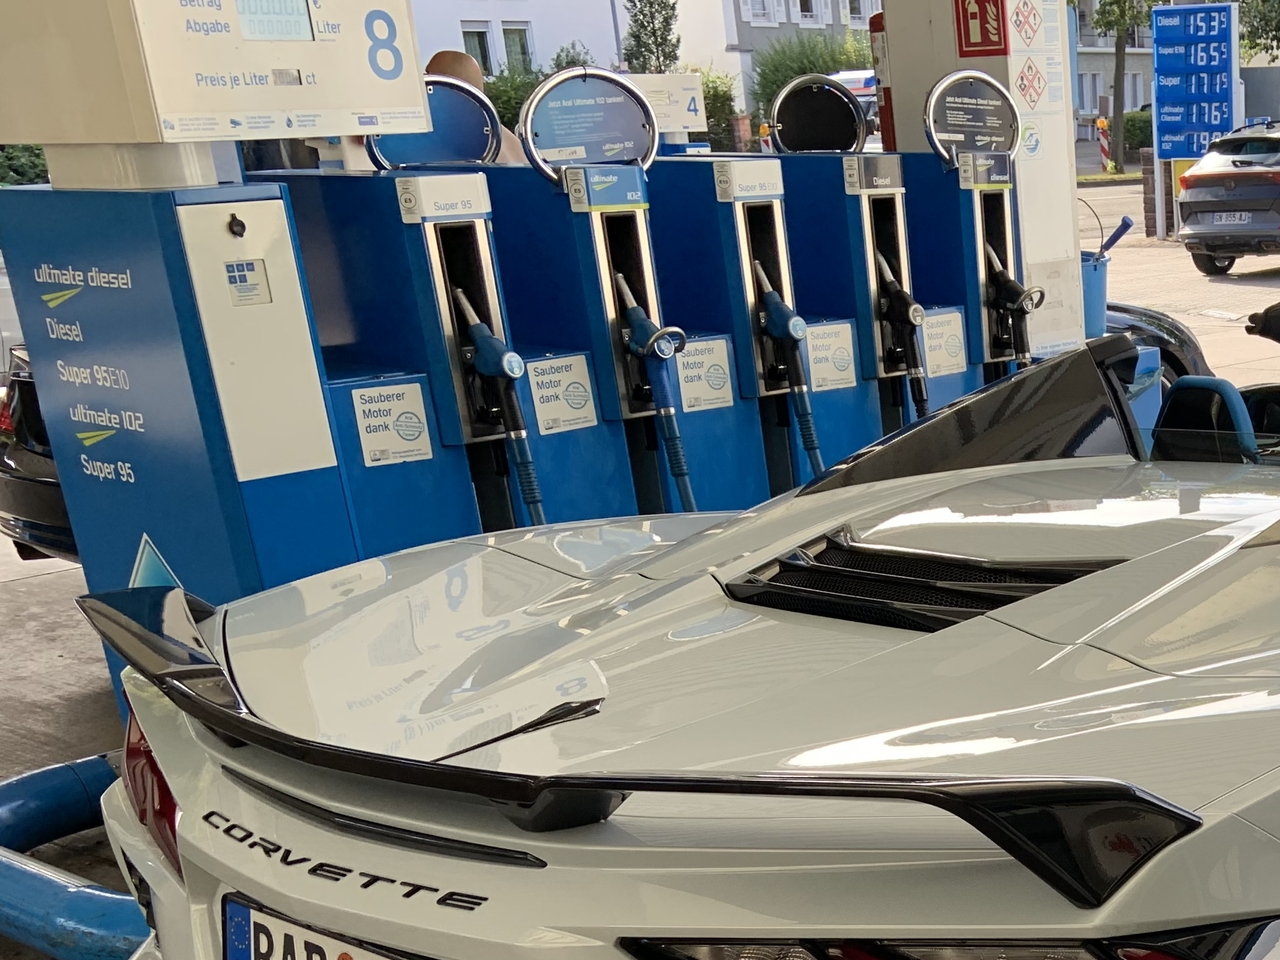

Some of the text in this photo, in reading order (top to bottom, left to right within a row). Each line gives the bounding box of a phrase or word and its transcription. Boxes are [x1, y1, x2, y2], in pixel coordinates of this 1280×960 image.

[1157, 16, 1180, 26] Diesel
[186, 19, 341, 36] Abgabe Liter
[364, 9, 403, 80] 8
[1158, 46, 1174, 55] Super
[196, 72, 226, 86] Preis
[229, 73, 240, 88] je
[244, 72, 269, 86] Liter
[306, 72, 317, 86] ct
[1159, 76, 1181, 86] Super
[687, 96, 699, 116] 4
[1160, 114, 1181, 122] Diesel
[873, 176, 890, 186] Diesel
[738, 184, 757, 192] Super
[627, 192, 641, 200] 102
[434, 200, 472, 212] Super 95
[34, 264, 131, 288] ultimate diesel
[46, 318, 83, 341] Diesel
[810, 331, 840, 340] Sauberer
[681, 347, 714, 358] Sauberer
[812, 344, 831, 352] Motor
[813, 355, 830, 364] dank
[533, 364, 572, 377] Sauberer
[682, 361, 704, 370] Motor
[56, 360, 92, 387] Super
[684, 373, 703, 383] dank
[536, 380, 562, 390] Motor
[360, 392, 405, 405] Sauberer
[539, 392, 561, 404] dank
[70, 404, 145, 432] ultimate 102
[362, 408, 392, 419] Motor
[366, 422, 390, 434] dank
[81, 454, 135, 483] Super 95
[202, 810, 489, 911] CORVETTE
